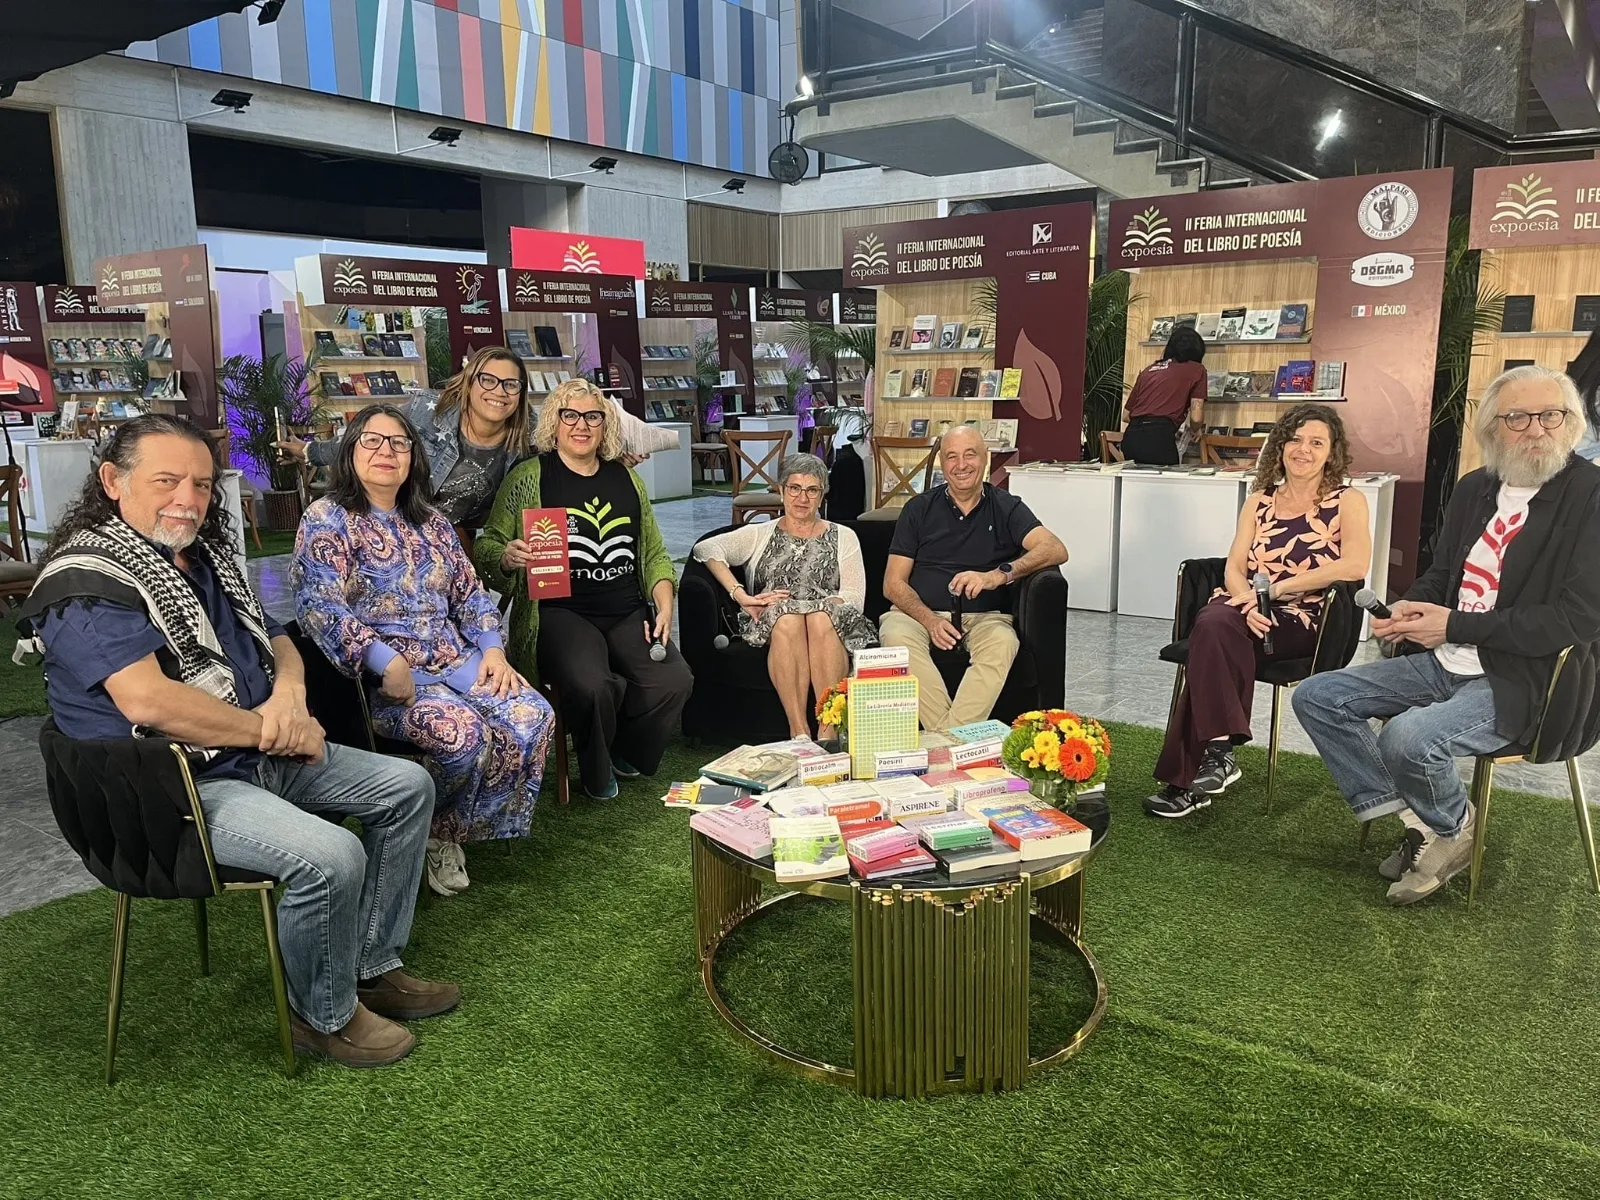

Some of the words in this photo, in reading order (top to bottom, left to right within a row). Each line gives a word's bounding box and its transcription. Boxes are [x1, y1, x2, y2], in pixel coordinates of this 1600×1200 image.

[1370, 184, 1409, 199] MALPAÍS
[1185, 218, 1193, 231] II
[1194, 215, 1222, 230] FERIA
[1225, 208, 1307, 228] INTERNACIONAL
[1489, 218, 1560, 237] expoesía
[897, 243, 902, 255] II
[903, 241, 925, 254] FERIA
[926, 235, 986, 252] INTERNACIONAL
[1184, 237, 1205, 254] DEL
[1207, 235, 1239, 252] LIBRO
[1242, 234, 1257, 249] DE
[1260, 228, 1302, 248] POESÍA
[1006, 249, 1031, 257] EDITORIAL
[1032, 247, 1045, 255] ARTE
[1050, 245, 1080, 253] LITERATURA
[1121, 244, 1173, 261] expoesía
[897, 260, 912, 274] DEL
[914, 258, 937, 273] LIBRO
[940, 257, 951, 271] DE
[952, 252, 983, 269] POESÍA
[377, 270, 393, 282] FERIA
[395, 273, 438, 283] INTERNACIONAL
[851, 265, 889, 280] expoesía
[1041, 271, 1057, 280] CUBA
[333, 285, 368, 297] expoesía
[373, 285, 386, 295] DEL
[387, 286, 406, 296] LIBRO
[407, 287, 415, 296] DE
[416, 286, 438, 298] POESÍA
[547, 282, 559, 290] FERIA
[560, 282, 591, 292] INTERNACIONAL
[544, 294, 553, 303] DEL
[554, 294, 568, 304] LIBRO
[568, 295, 575, 304] DE
[575, 294, 591, 304] POESÍA
[1374, 304, 1407, 316] MÉXICO
[859, 653, 897, 661] Alciromicina
[955, 747, 990, 760] Lectocatil
[804, 762, 836, 772] Bibliocalm
[962, 786, 1006, 799] Libroprofeno
[900, 800, 940, 812] ASPIRENE
